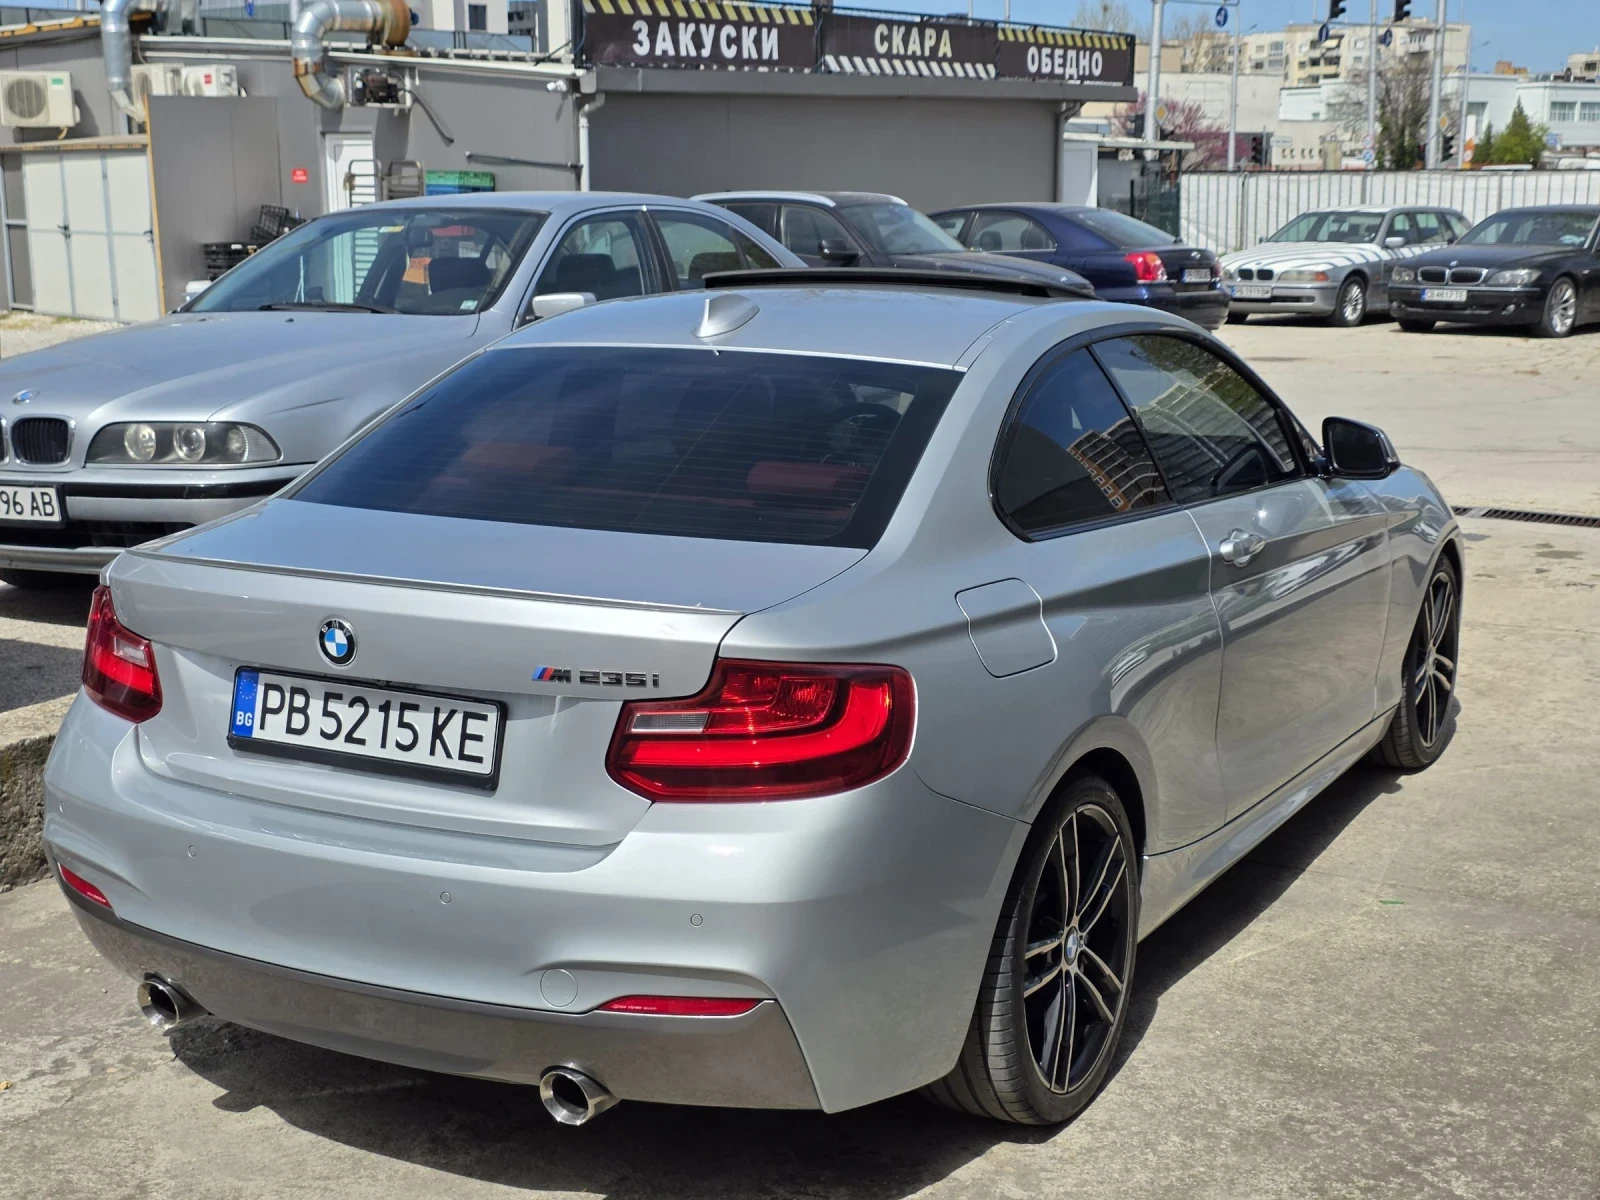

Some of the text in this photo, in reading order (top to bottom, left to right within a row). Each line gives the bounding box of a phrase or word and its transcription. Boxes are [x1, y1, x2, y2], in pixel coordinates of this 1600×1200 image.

[632, 20, 779, 61] ЗАКУСКИ
[874, 23, 953, 58] СКАРА
[1026, 46, 1103, 80] ОБЕДНО
[0, 490, 55, 517] 96 AB
[321, 619, 352, 637] BMW
[236, 711, 253, 727] BG
[259, 682, 488, 764] PB 5215 KE
